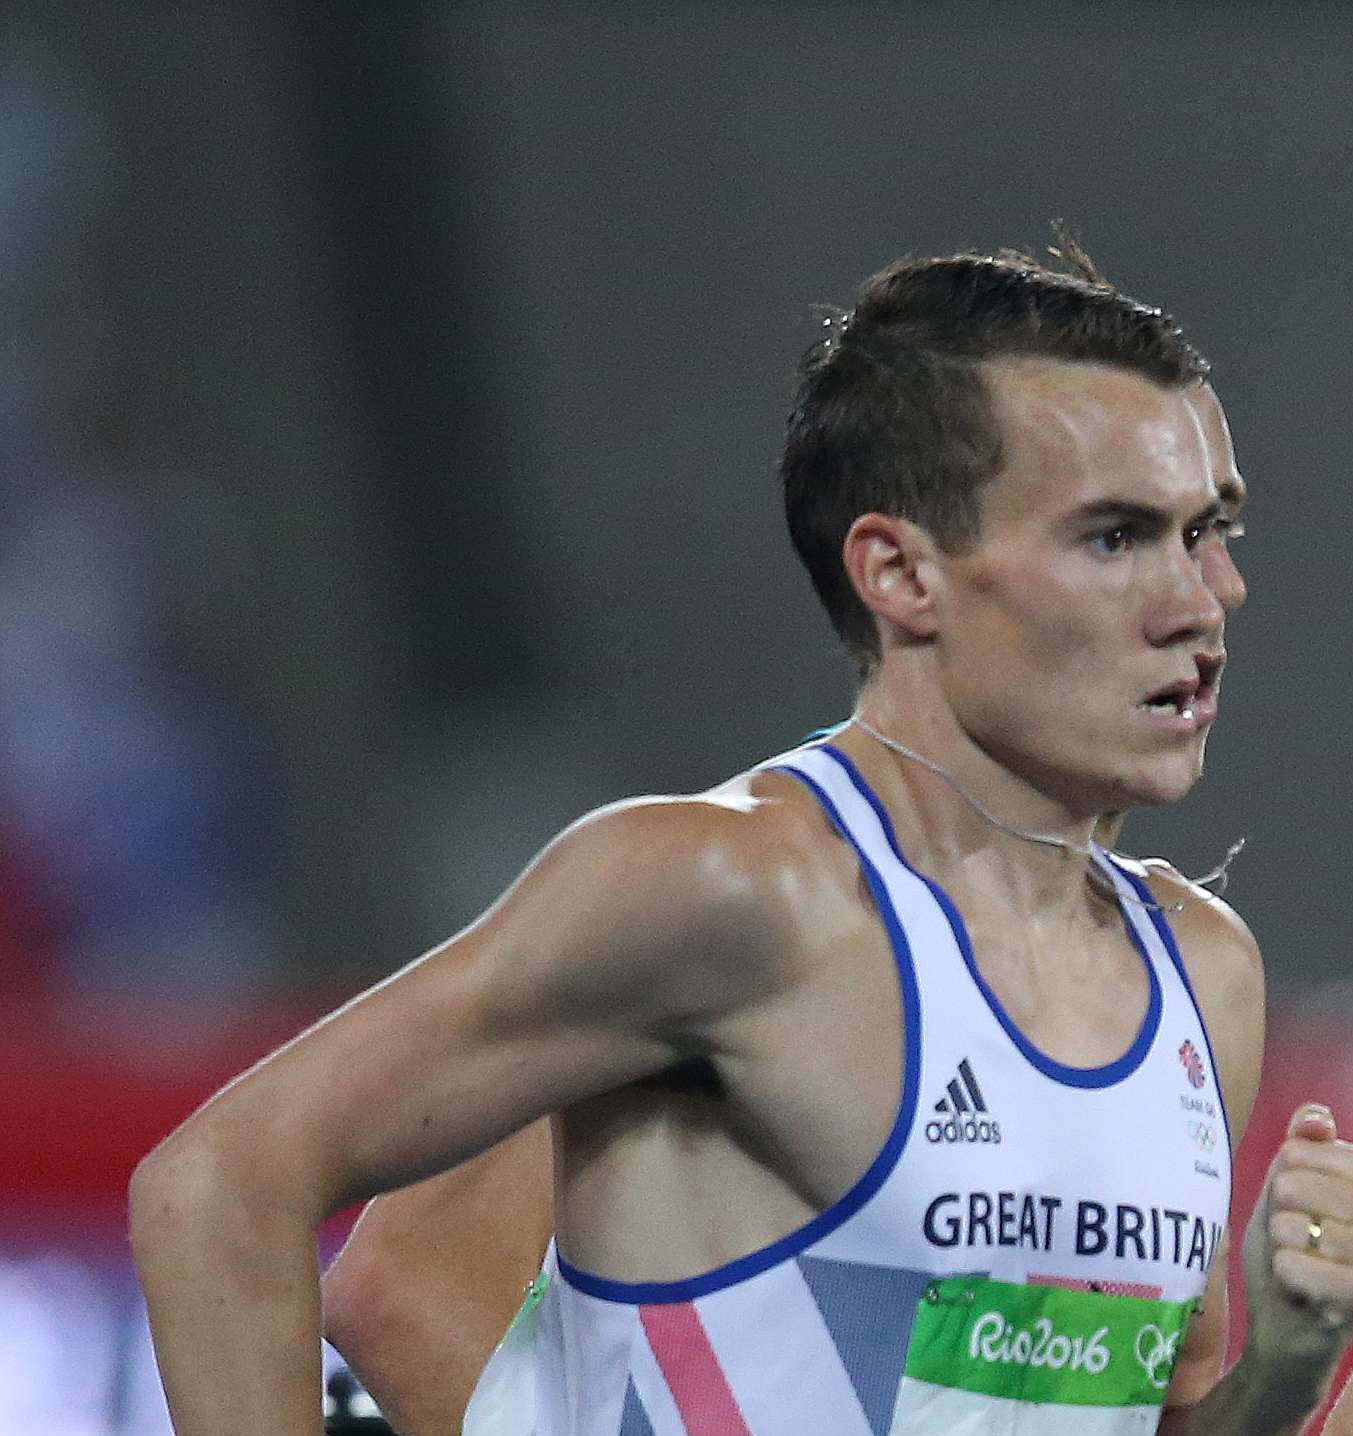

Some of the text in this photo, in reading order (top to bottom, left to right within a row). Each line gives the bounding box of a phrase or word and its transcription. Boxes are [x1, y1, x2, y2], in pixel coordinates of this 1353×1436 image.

[925, 1113, 1001, 1144] adidas
[923, 1192, 1062, 1250] GREAT
[968, 1312, 1111, 1373] Rio2016
